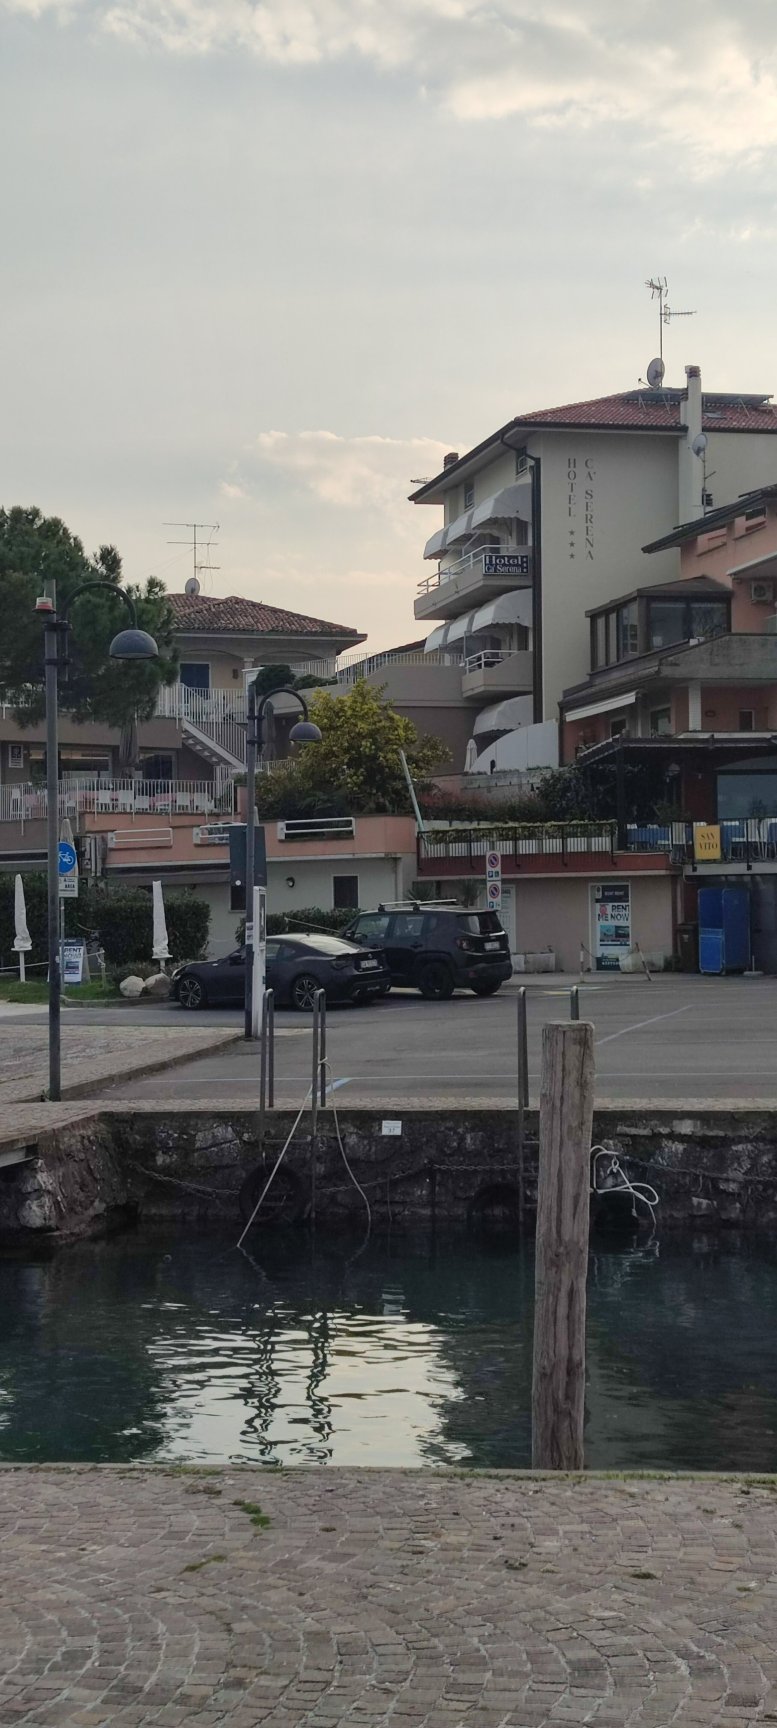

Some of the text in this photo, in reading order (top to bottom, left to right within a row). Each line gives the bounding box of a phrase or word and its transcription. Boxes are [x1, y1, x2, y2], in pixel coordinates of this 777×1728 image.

[568, 458, 576, 518] HOTEL
[584, 489, 594, 561] SERENA
[486, 556, 521, 564] Hotel
[496, 564, 522, 572] Serena
[700, 842, 718, 850] VITO
